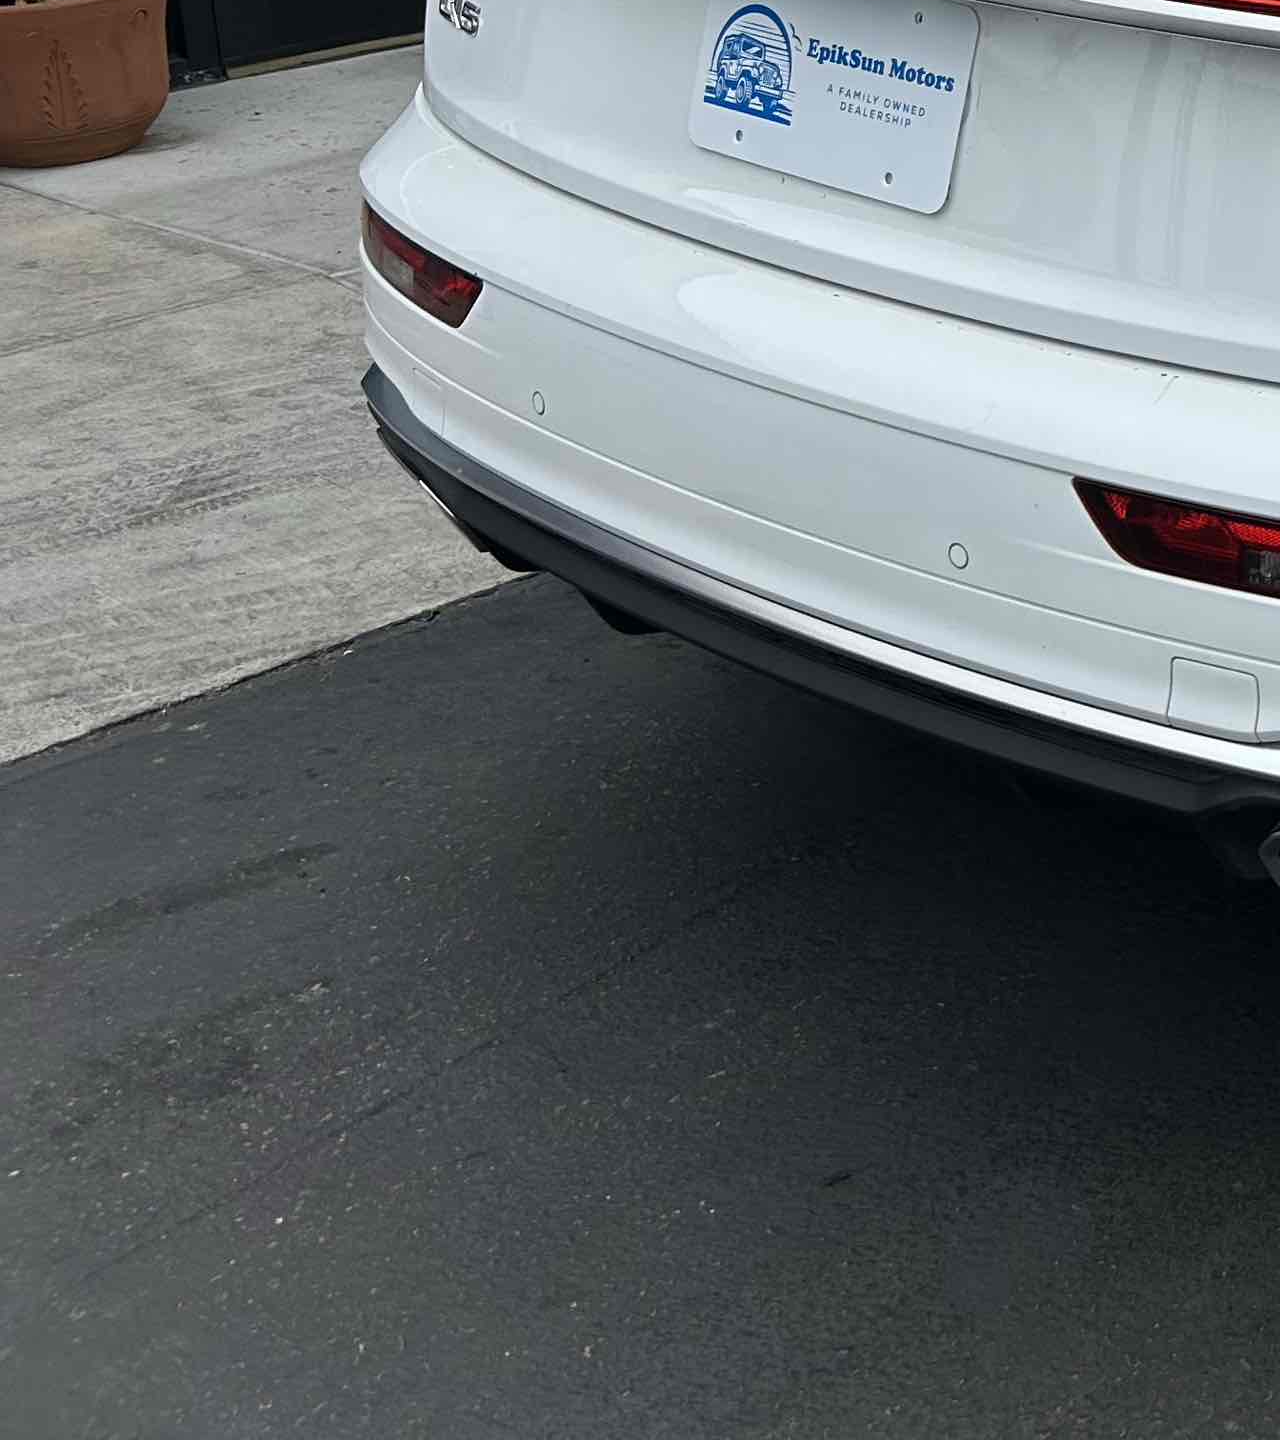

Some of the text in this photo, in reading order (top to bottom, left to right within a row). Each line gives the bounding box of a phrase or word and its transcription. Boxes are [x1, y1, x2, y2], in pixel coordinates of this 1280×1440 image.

[806, 37, 956, 93] EpikSun Motors
[826, 83, 926, 118] A FAMILY OWNED
[838, 101, 912, 128] DEALERSHIP
